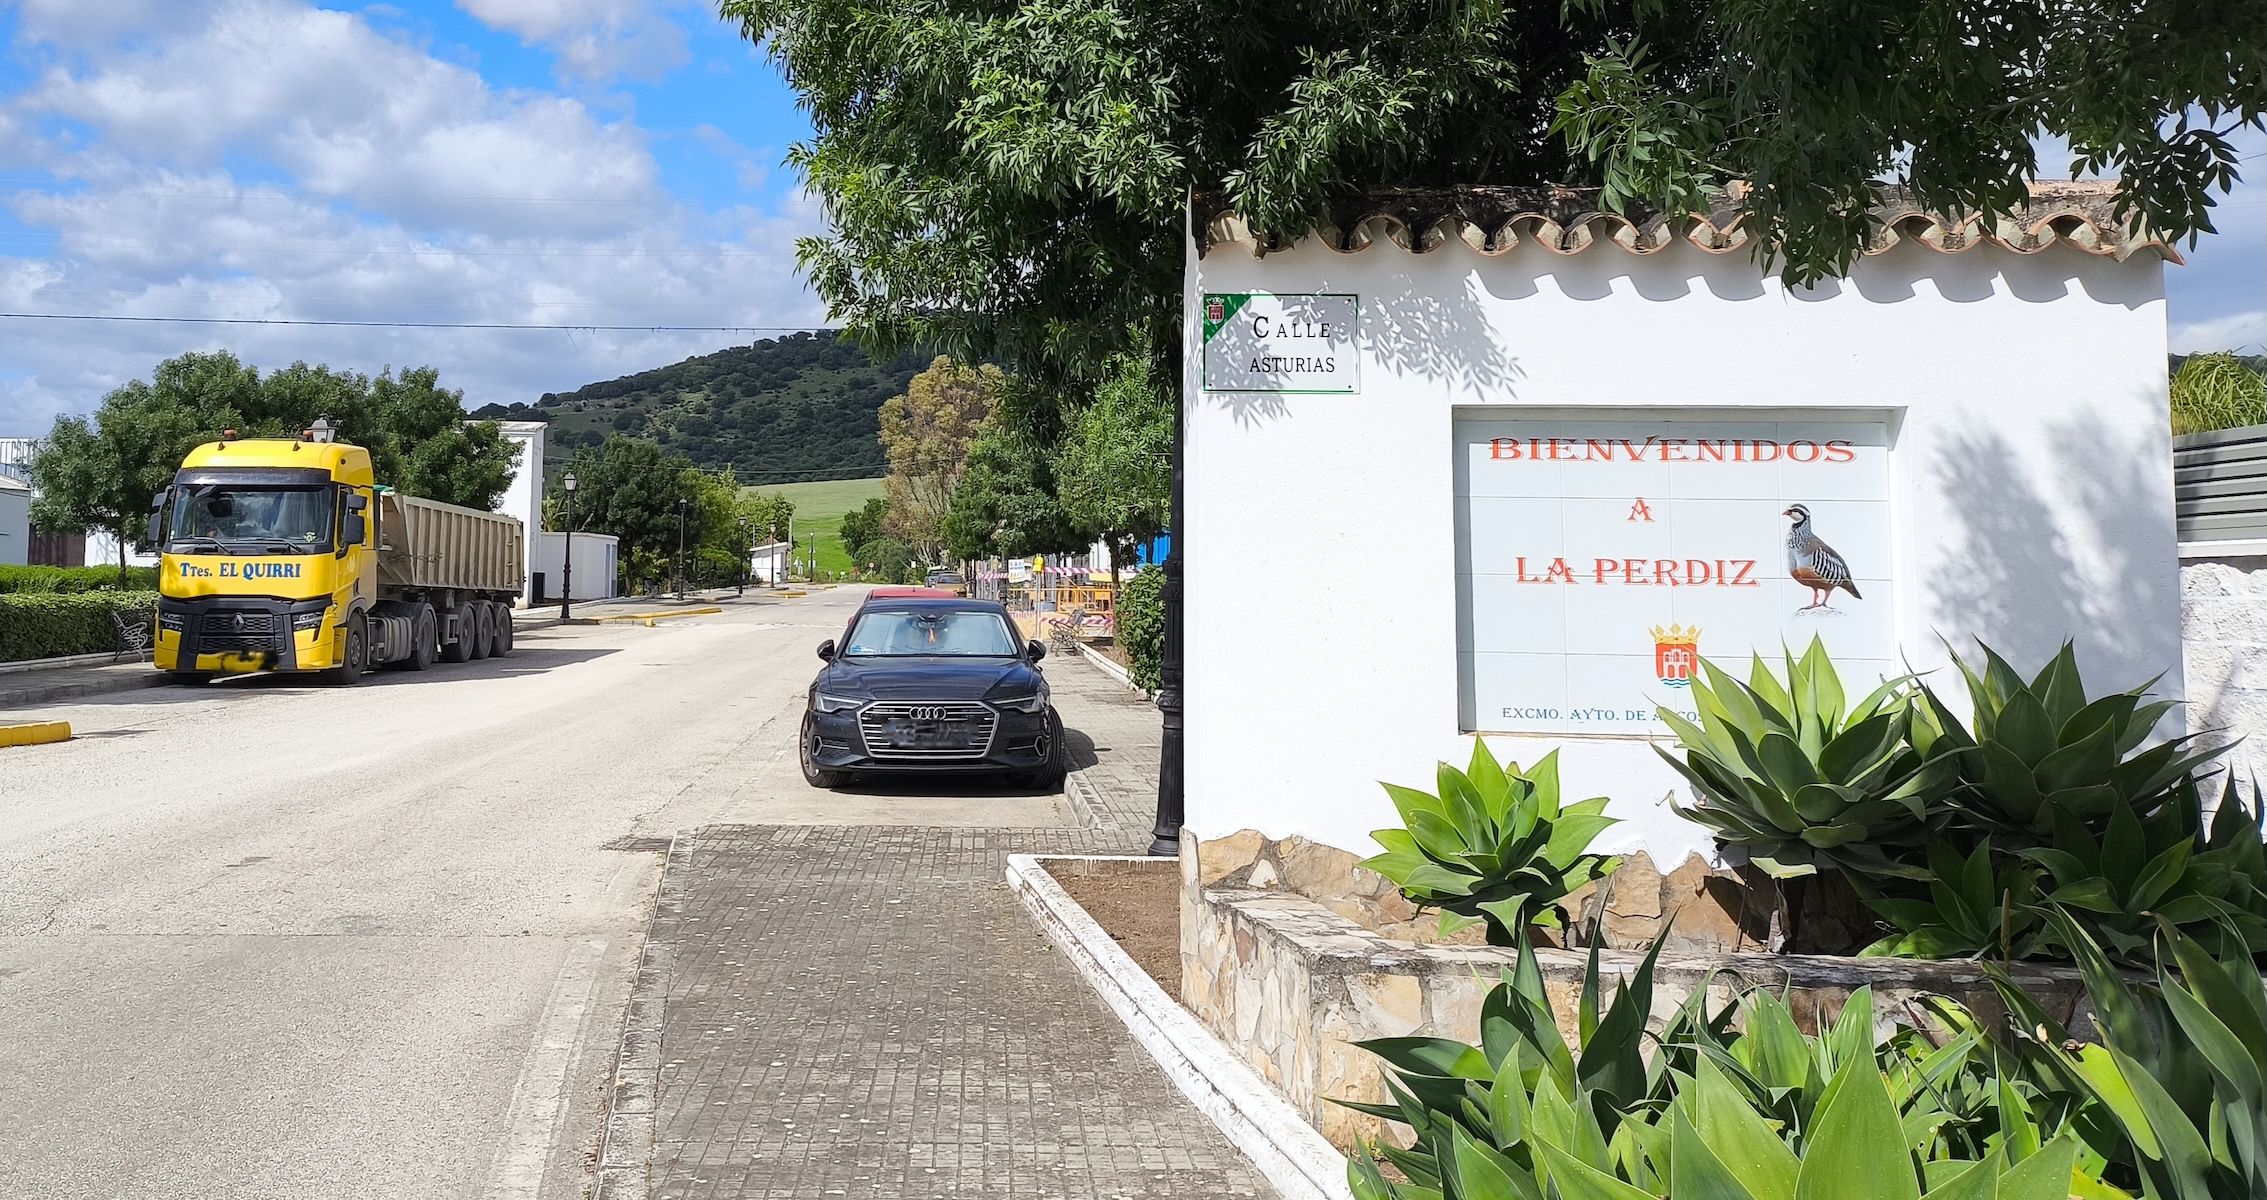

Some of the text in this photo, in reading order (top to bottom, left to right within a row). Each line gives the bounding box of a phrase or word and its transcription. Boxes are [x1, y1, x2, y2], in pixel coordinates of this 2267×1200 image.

[1250, 357, 1335, 373] ASTURIAS
[1488, 435, 1858, 463] BIENVENIDOS
[1627, 497, 1656, 522] A
[219, 562, 239, 577] EL
[243, 562, 301, 580] QUIRRI
[1515, 557, 1761, 588] LA PERDIZ
[1502, 707, 1564, 721] EXCMO.
[1570, 708, 1620, 721] AYTO.
[1625, 710, 1647, 721] DE
